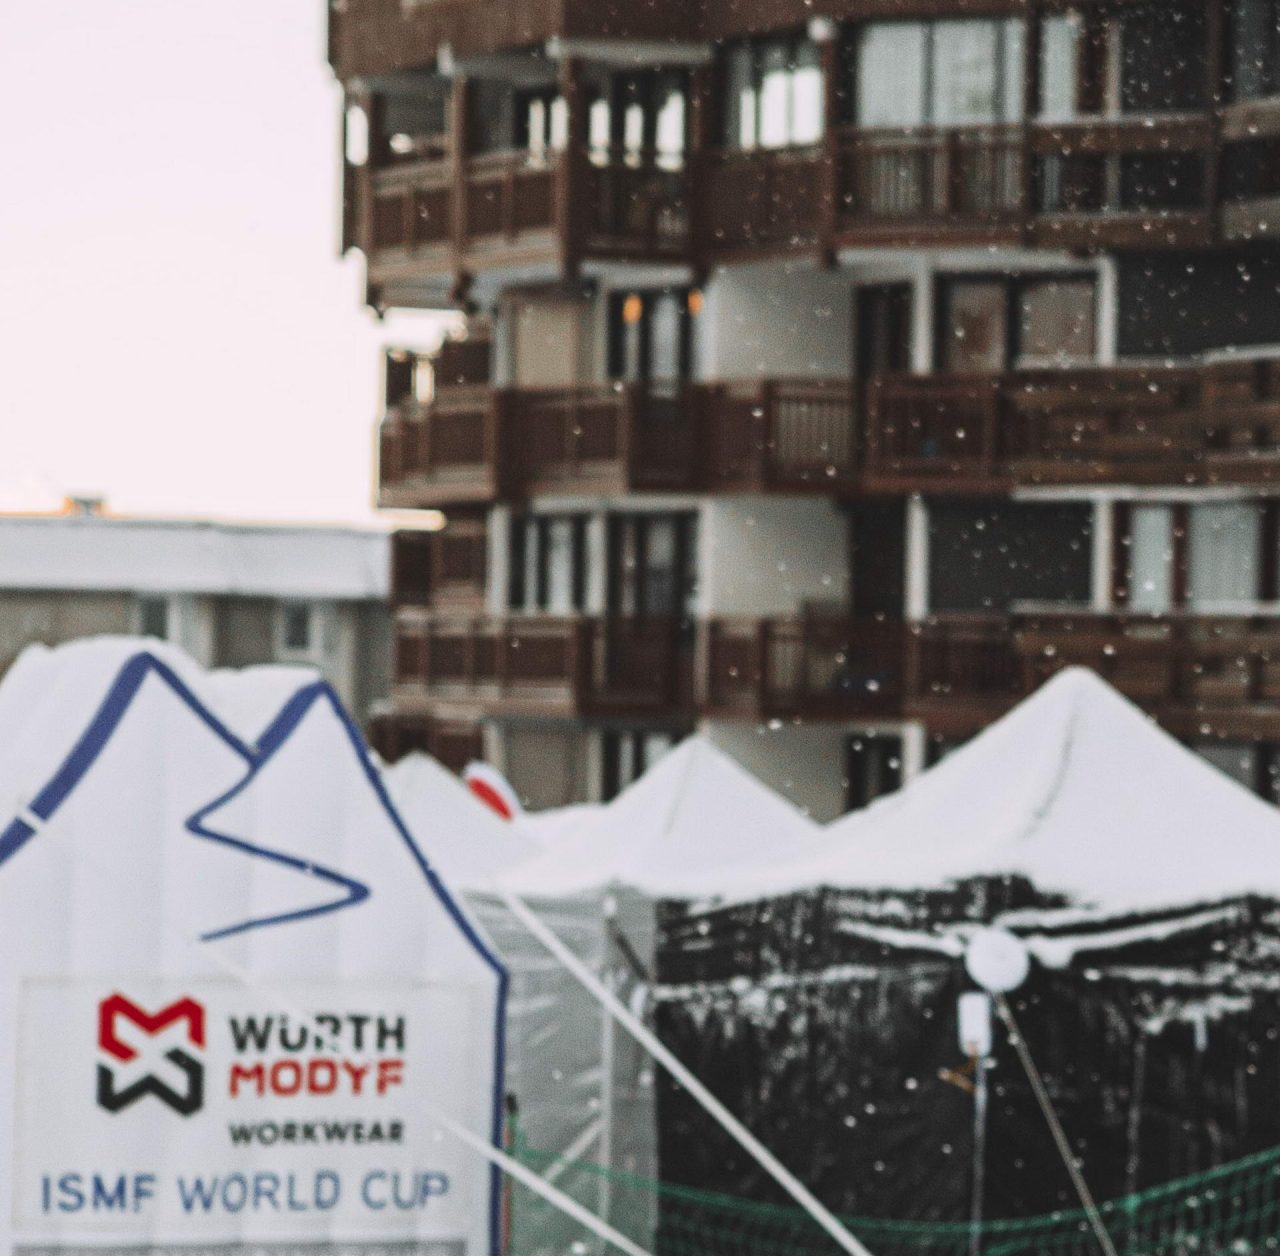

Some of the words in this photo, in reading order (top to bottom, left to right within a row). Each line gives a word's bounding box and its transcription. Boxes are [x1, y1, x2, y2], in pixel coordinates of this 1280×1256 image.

[229, 1060, 405, 1097] MODYF
[228, 1120, 405, 1147] WORKWEAR
[41, 1173, 156, 1214] ISMF
[177, 1170, 341, 1213] WORLD
[360, 1169, 450, 1211] CUP
